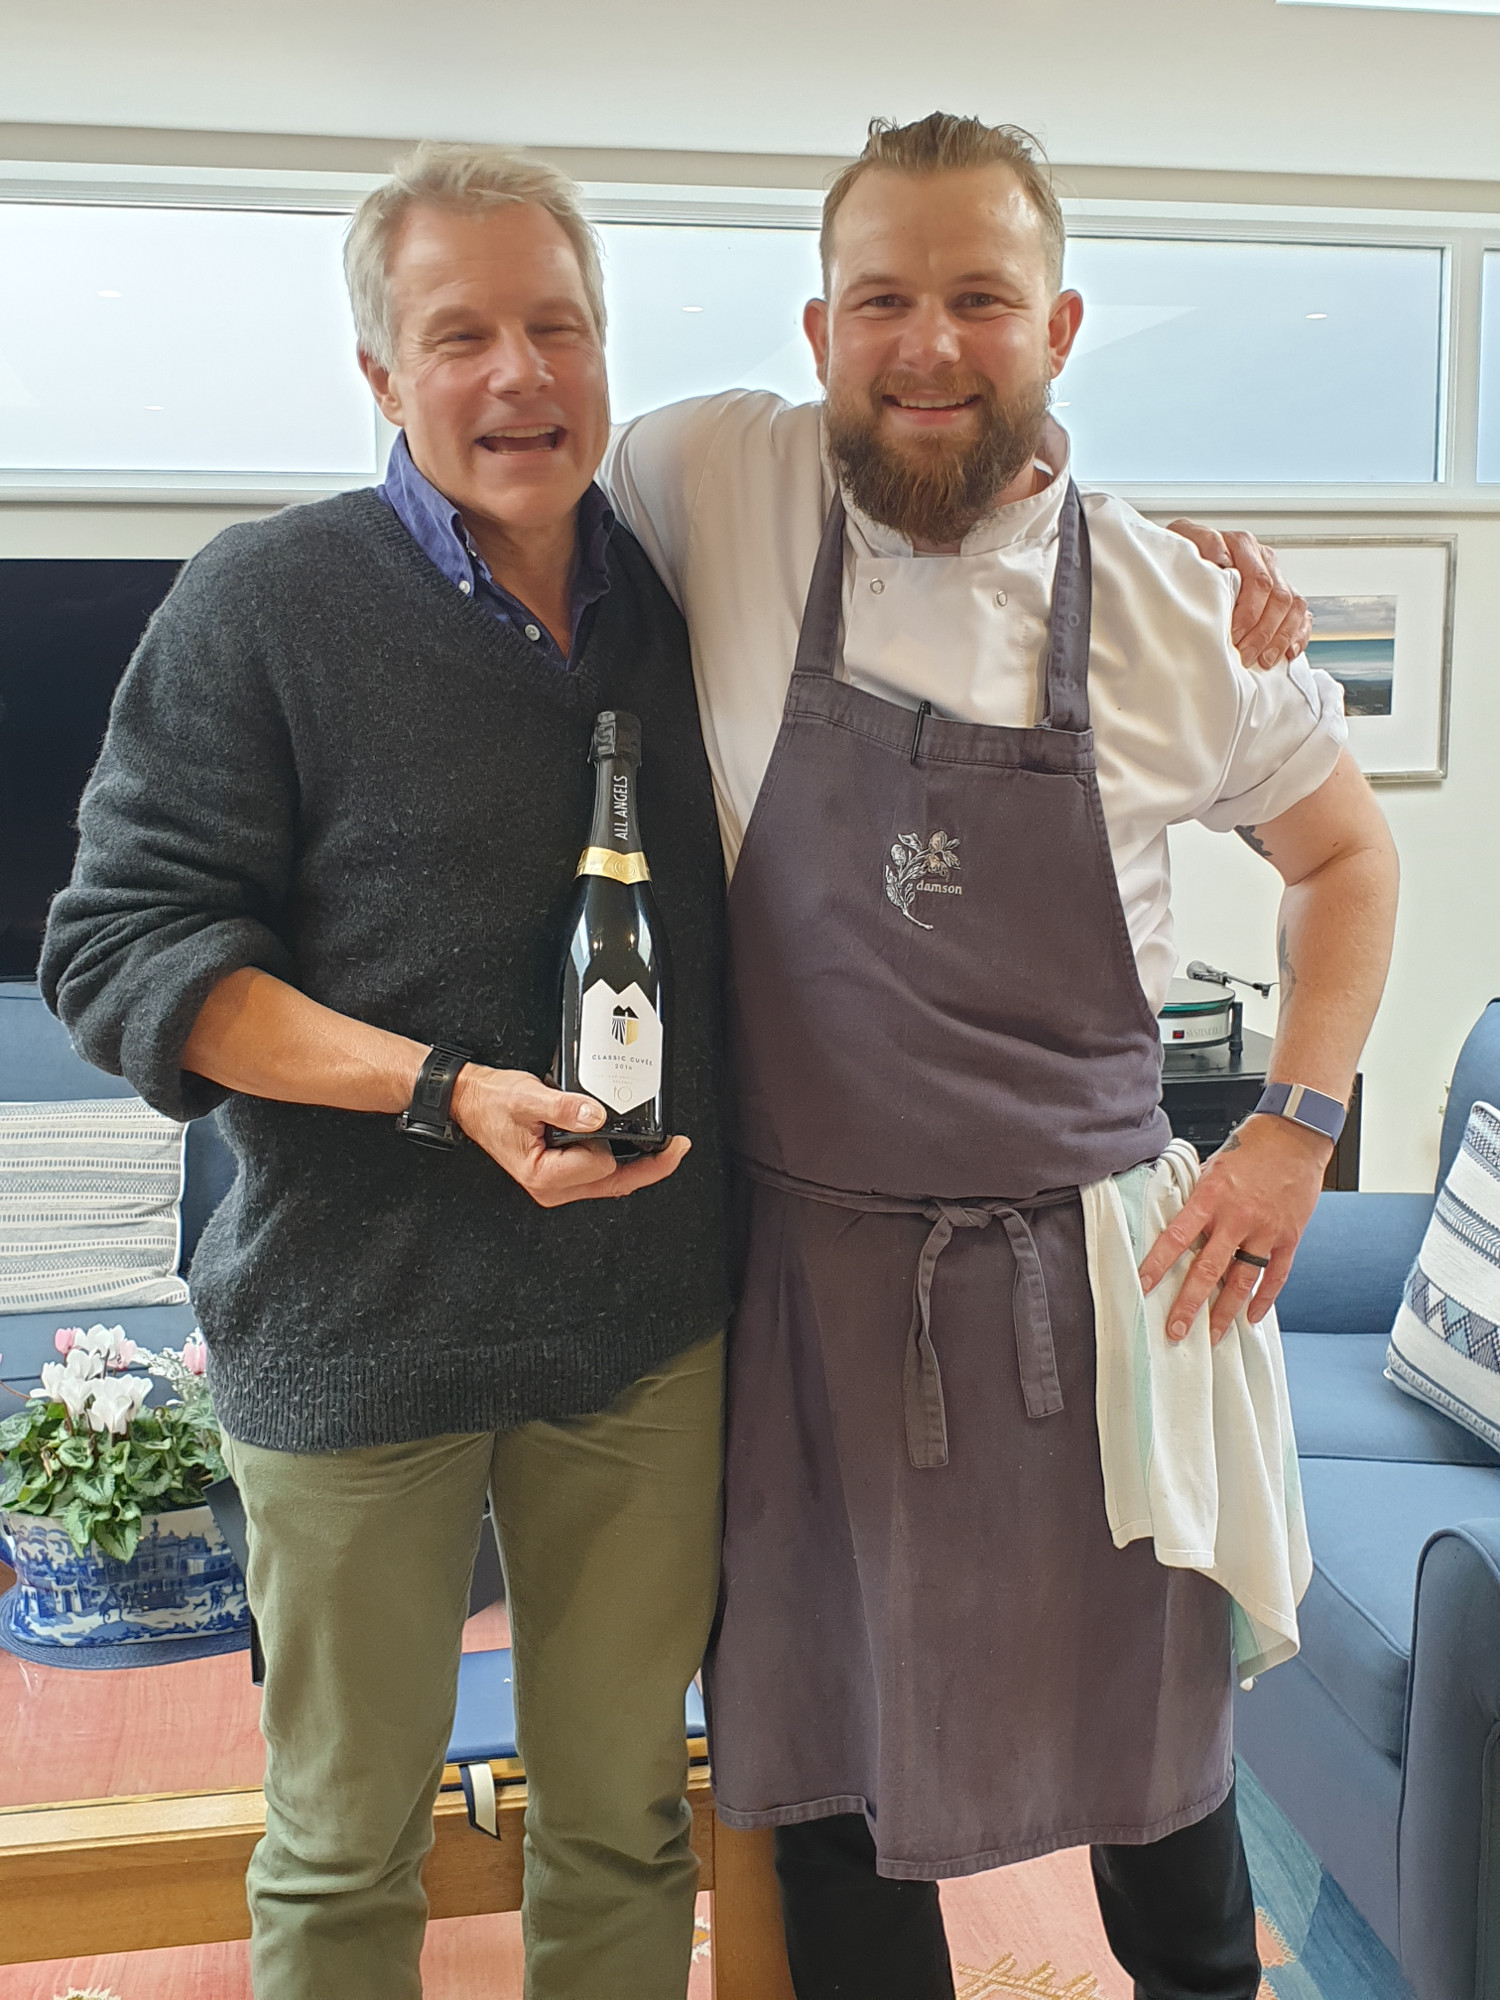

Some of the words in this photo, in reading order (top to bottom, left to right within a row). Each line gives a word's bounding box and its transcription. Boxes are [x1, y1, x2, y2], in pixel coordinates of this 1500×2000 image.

[613, 775, 628, 819] ANGELS
[614, 822, 629, 841] ALL
[916, 879, 963, 895] damson
[592, 1054, 626, 1062] CLASSIC
